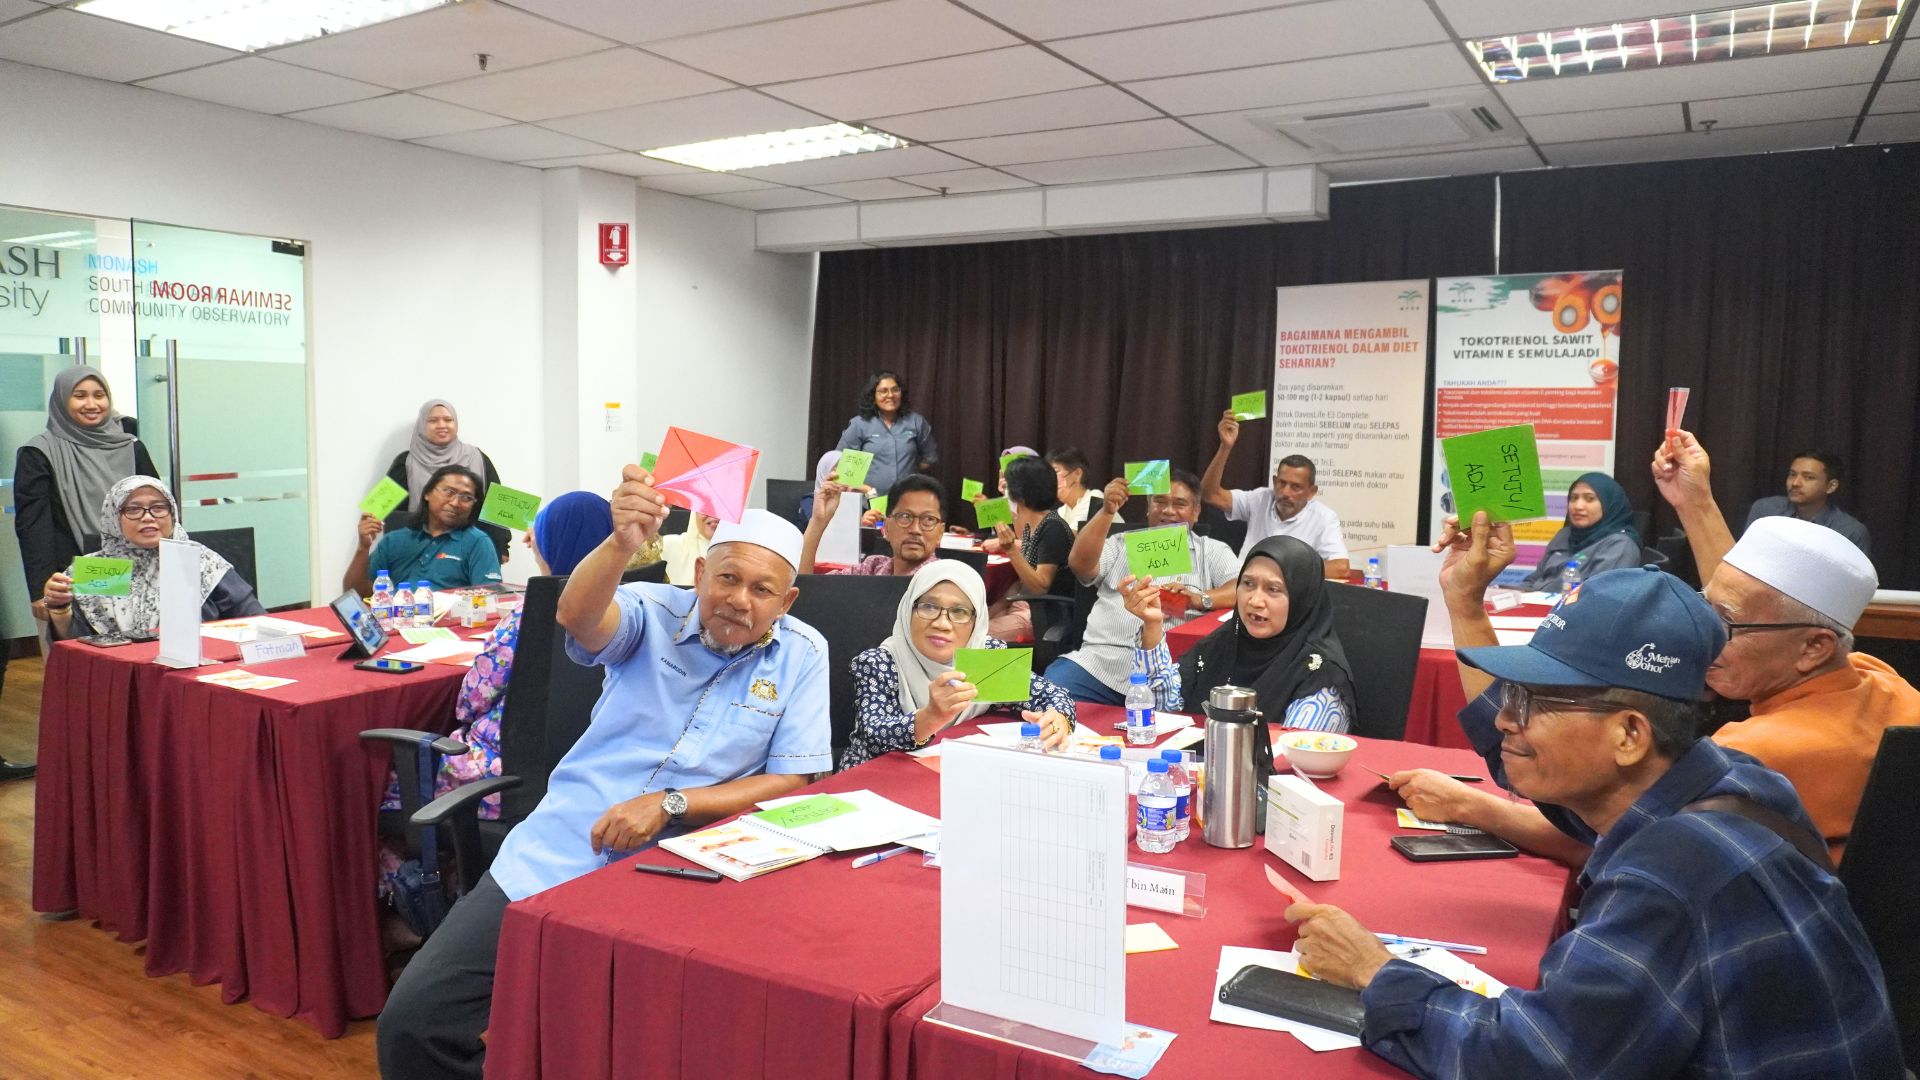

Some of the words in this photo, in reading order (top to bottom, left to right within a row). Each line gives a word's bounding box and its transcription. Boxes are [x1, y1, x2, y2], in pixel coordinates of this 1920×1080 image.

[89, 275, 143, 294] SOUTH
[89, 298, 187, 318] COMMUNITY
[192, 305, 290, 326] OBSERVATORY
[1280, 329, 1341, 342] BAGAIMANA
[1344, 327, 1410, 340] MENGAMBIL
[1460, 336, 1549, 346] TOKOTRIENOL
[1552, 334, 1594, 345] SAWIT
[1280, 343, 1349, 355] TOKOTRIENOL
[1352, 342, 1390, 354] DALAM
[1393, 341, 1419, 353] DIET
[1453, 349, 1504, 359] VITAMIN
[1508, 348, 1515, 359] E
[1518, 348, 1600, 359] SEMULAJADI
[1279, 357, 1336, 369] SEHARIAN?
[1290, 384, 1305, 393] yang
[1319, 421, 1350, 429] SEBELUM
[1369, 422, 1400, 430] SELEPAS
[1337, 433, 1354, 441] yang
[1332, 470, 1363, 478] SELEPAS
[1388, 472, 1404, 480] atau
[1464, 463, 1486, 493] ADA
[1501, 443, 1534, 512] SETUJU/
[1366, 481, 1389, 489] doktor
[1364, 521, 1380, 529] suhu
[1381, 521, 1395, 529] bilik
[1136, 532, 1183, 553] SETUJU/
[1347, 532, 1378, 542] langsung
[1147, 557, 1170, 569] ADA
[1131, 878, 1147, 891] bin
